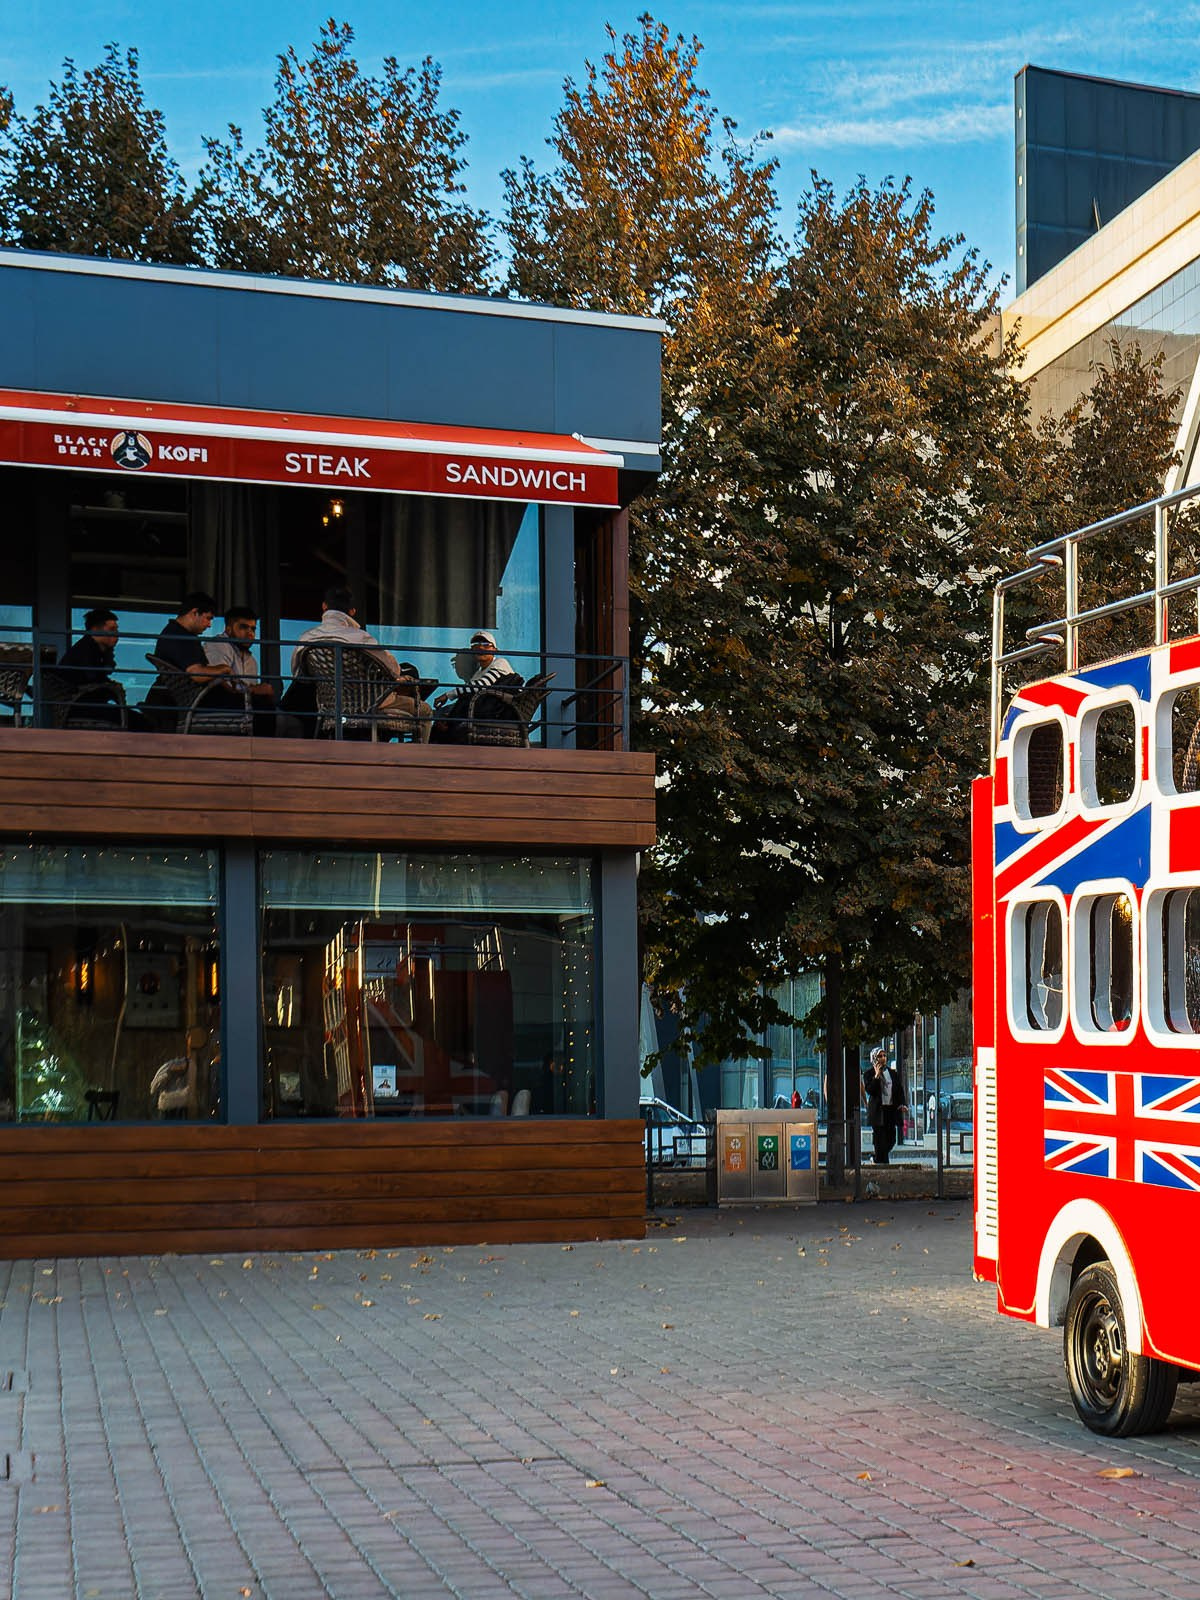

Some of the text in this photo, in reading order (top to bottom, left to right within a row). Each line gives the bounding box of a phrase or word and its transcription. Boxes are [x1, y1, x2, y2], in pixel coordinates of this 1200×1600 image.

[54, 434, 108, 448] BLACK
[58, 445, 102, 457] BEAR
[285, 453, 371, 478] STEAK
[446, 462, 586, 492] SANDWICH
